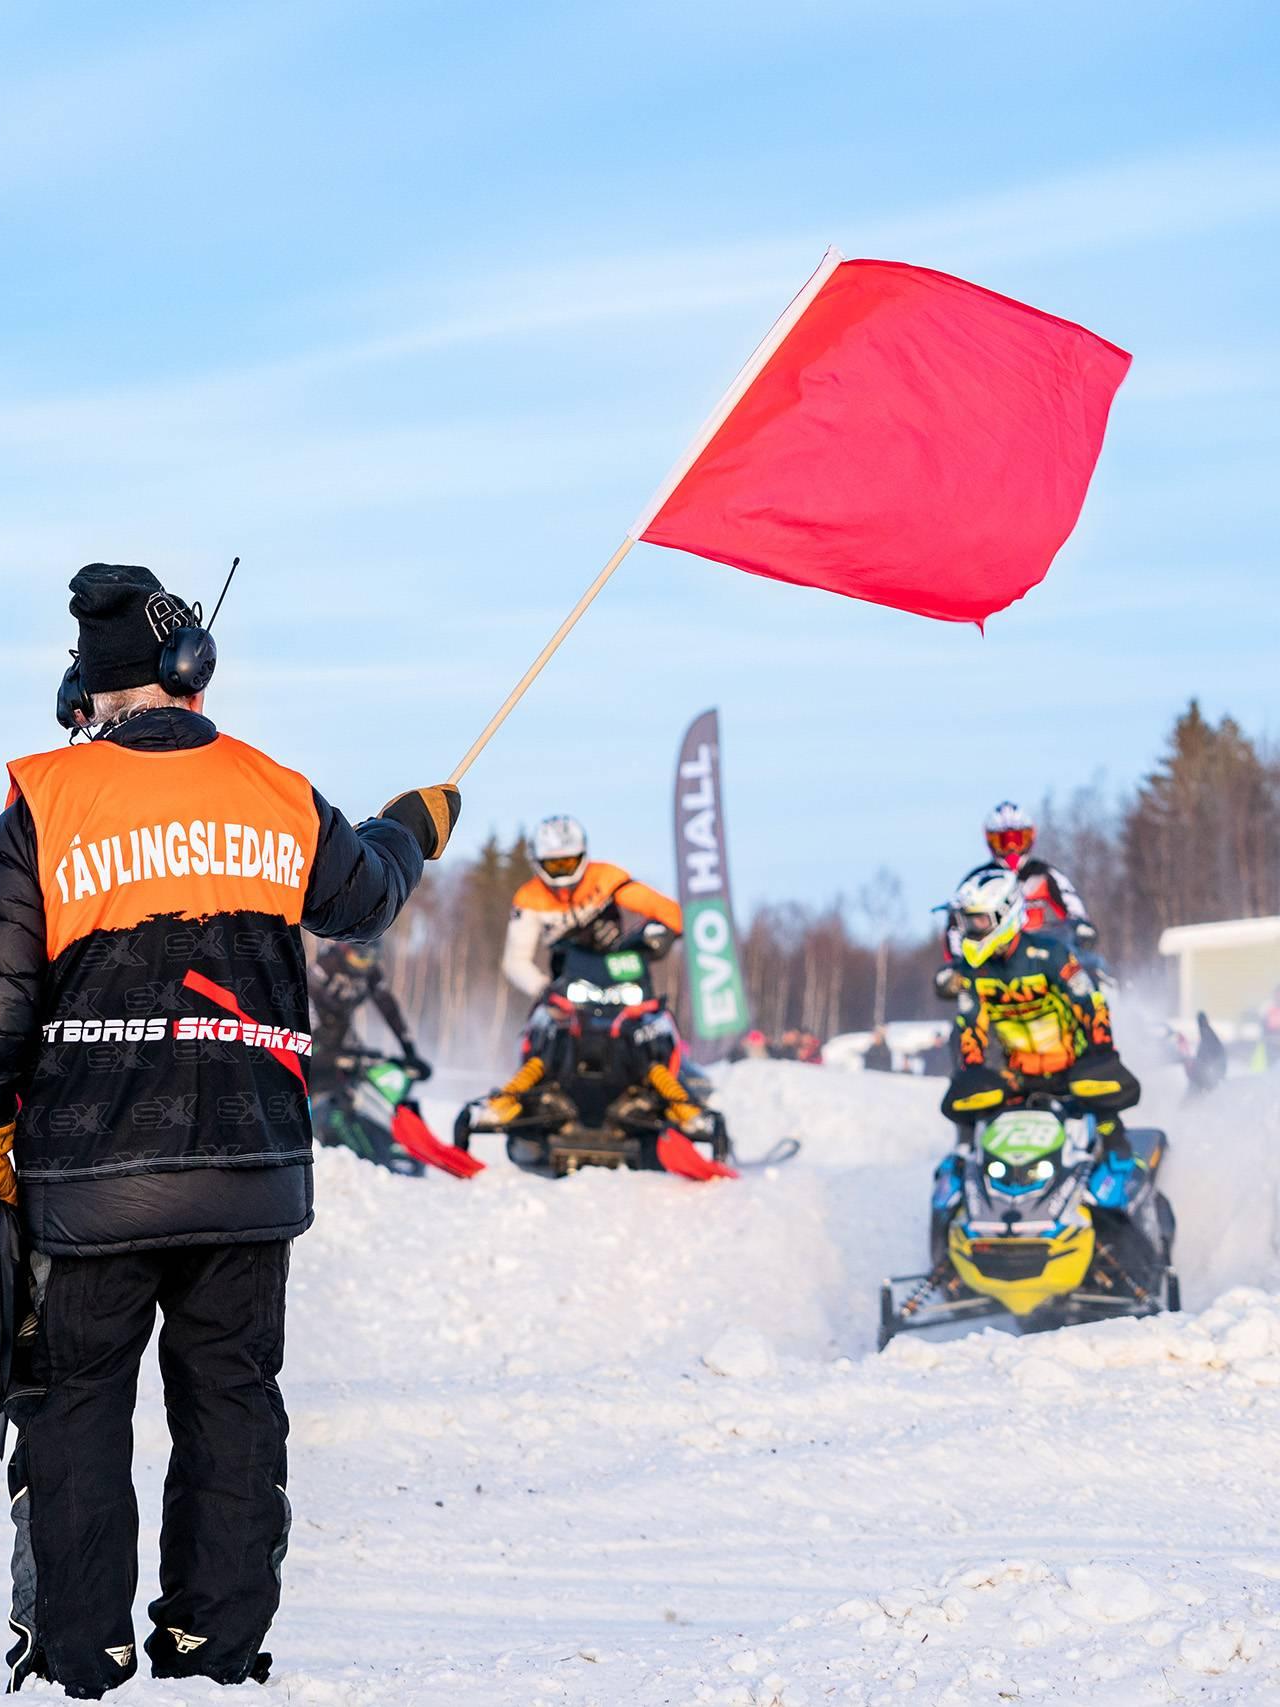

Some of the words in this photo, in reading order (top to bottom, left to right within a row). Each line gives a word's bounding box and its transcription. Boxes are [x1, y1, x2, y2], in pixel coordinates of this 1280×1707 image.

[680, 743, 723, 893] HALL
[692, 907, 738, 1027] EVO
[42, 1018, 167, 1043] YBORGS
